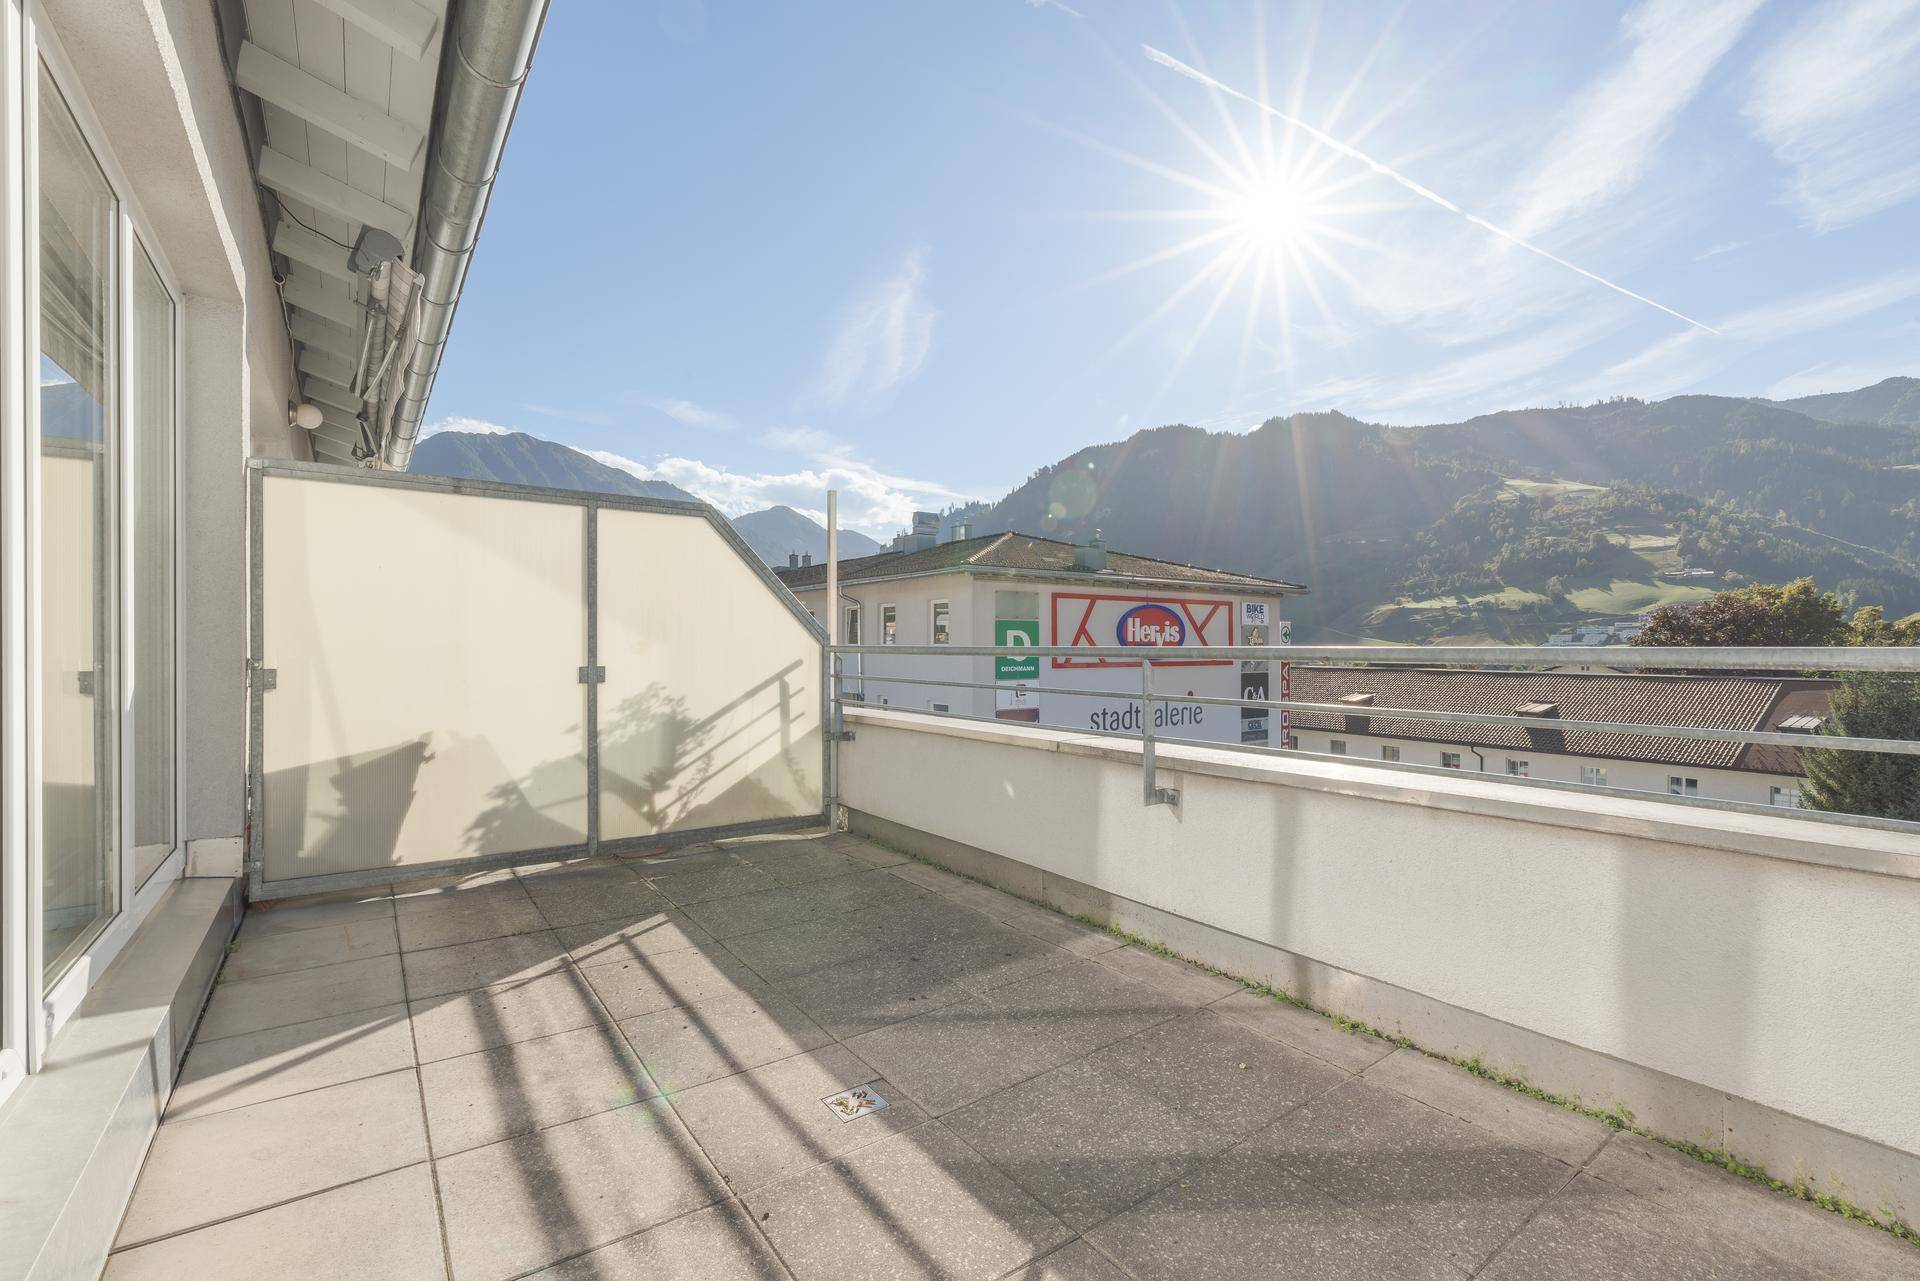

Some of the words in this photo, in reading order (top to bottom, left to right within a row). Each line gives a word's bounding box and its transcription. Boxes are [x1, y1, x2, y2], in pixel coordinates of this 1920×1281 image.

[1246, 604, 1264, 613] BIKE
[1006, 630, 1031, 661] D
[1127, 617, 1180, 647] Hervis
[1243, 686, 1265, 701] C&A
[1090, 702, 1203, 734] stadtalerie
